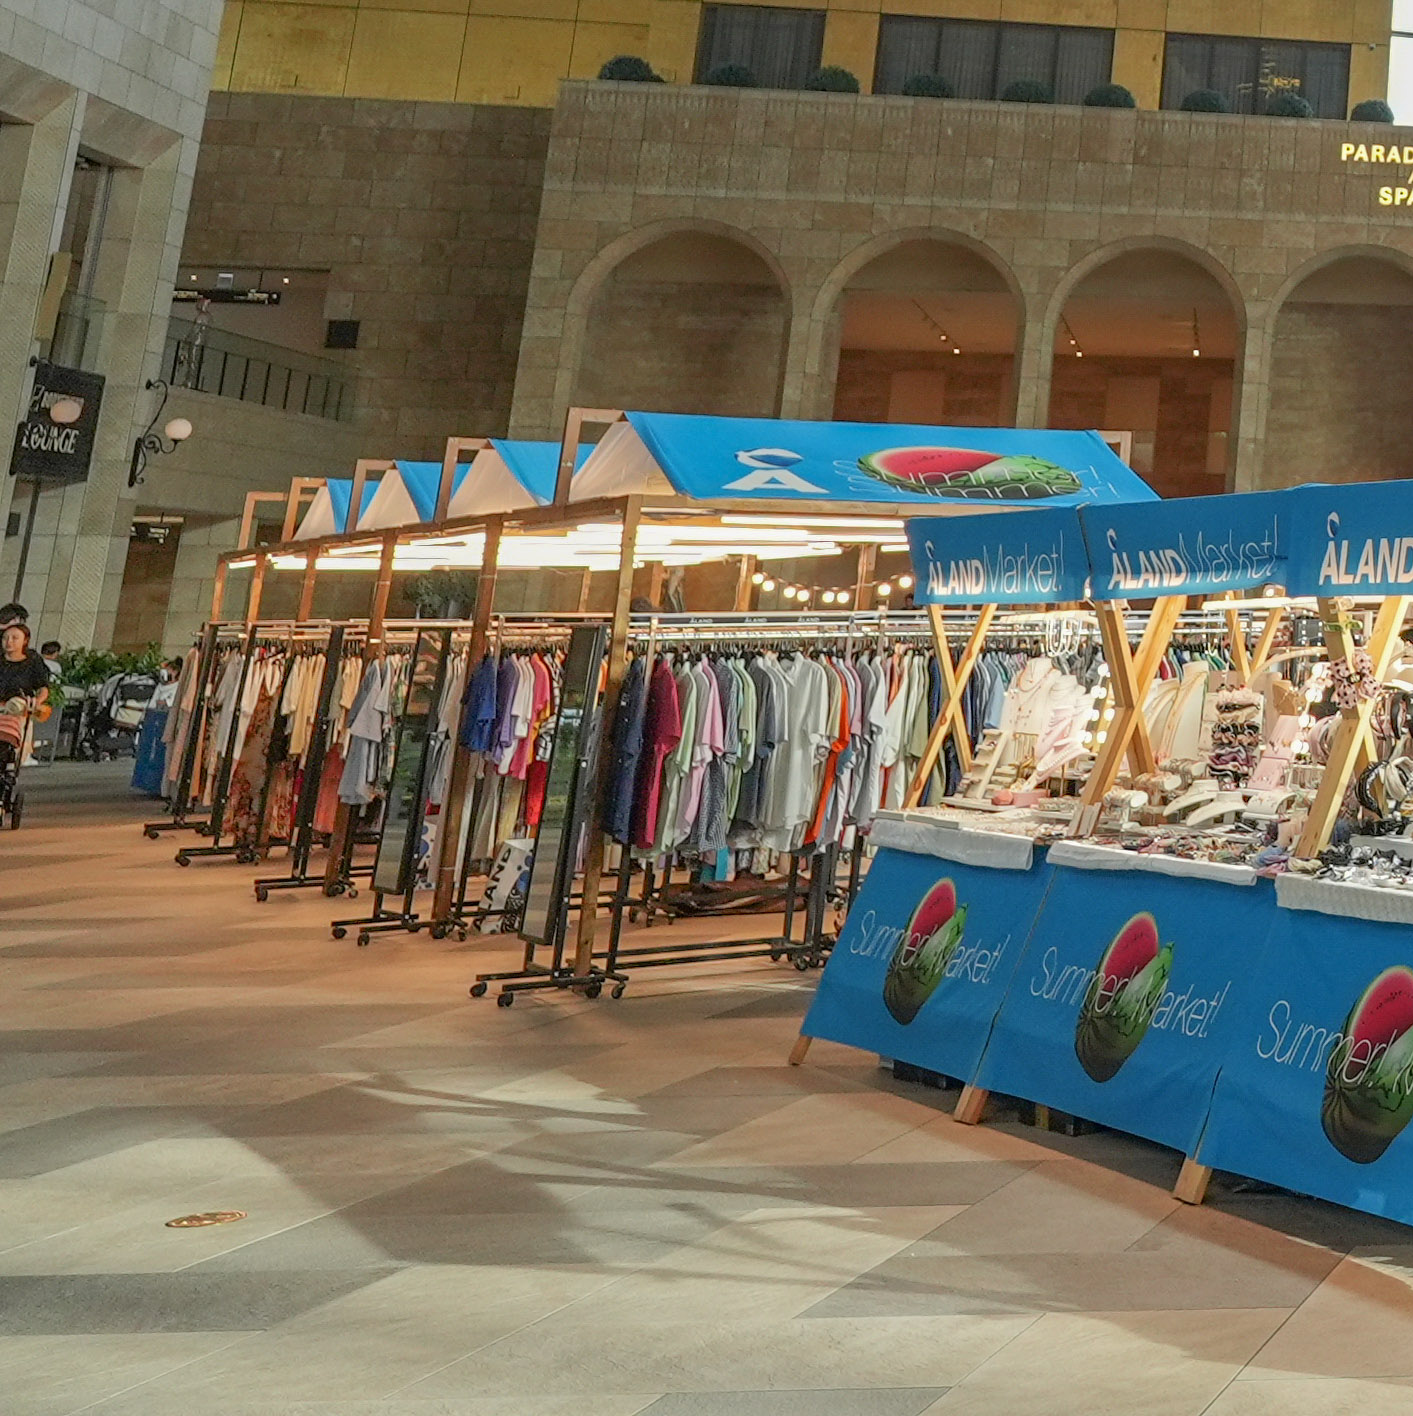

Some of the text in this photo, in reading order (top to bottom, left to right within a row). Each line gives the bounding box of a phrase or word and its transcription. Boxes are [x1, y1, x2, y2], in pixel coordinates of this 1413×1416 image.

[22, 423, 79, 454] LOUNGE
[983, 530, 1064, 594] Market!
[1178, 514, 1280, 582] Market!
[850, 910, 1011, 986] Summer! Market!
[1030, 946, 1231, 1039] Summer! Market!
[1256, 999, 1398, 1089] Summer!
